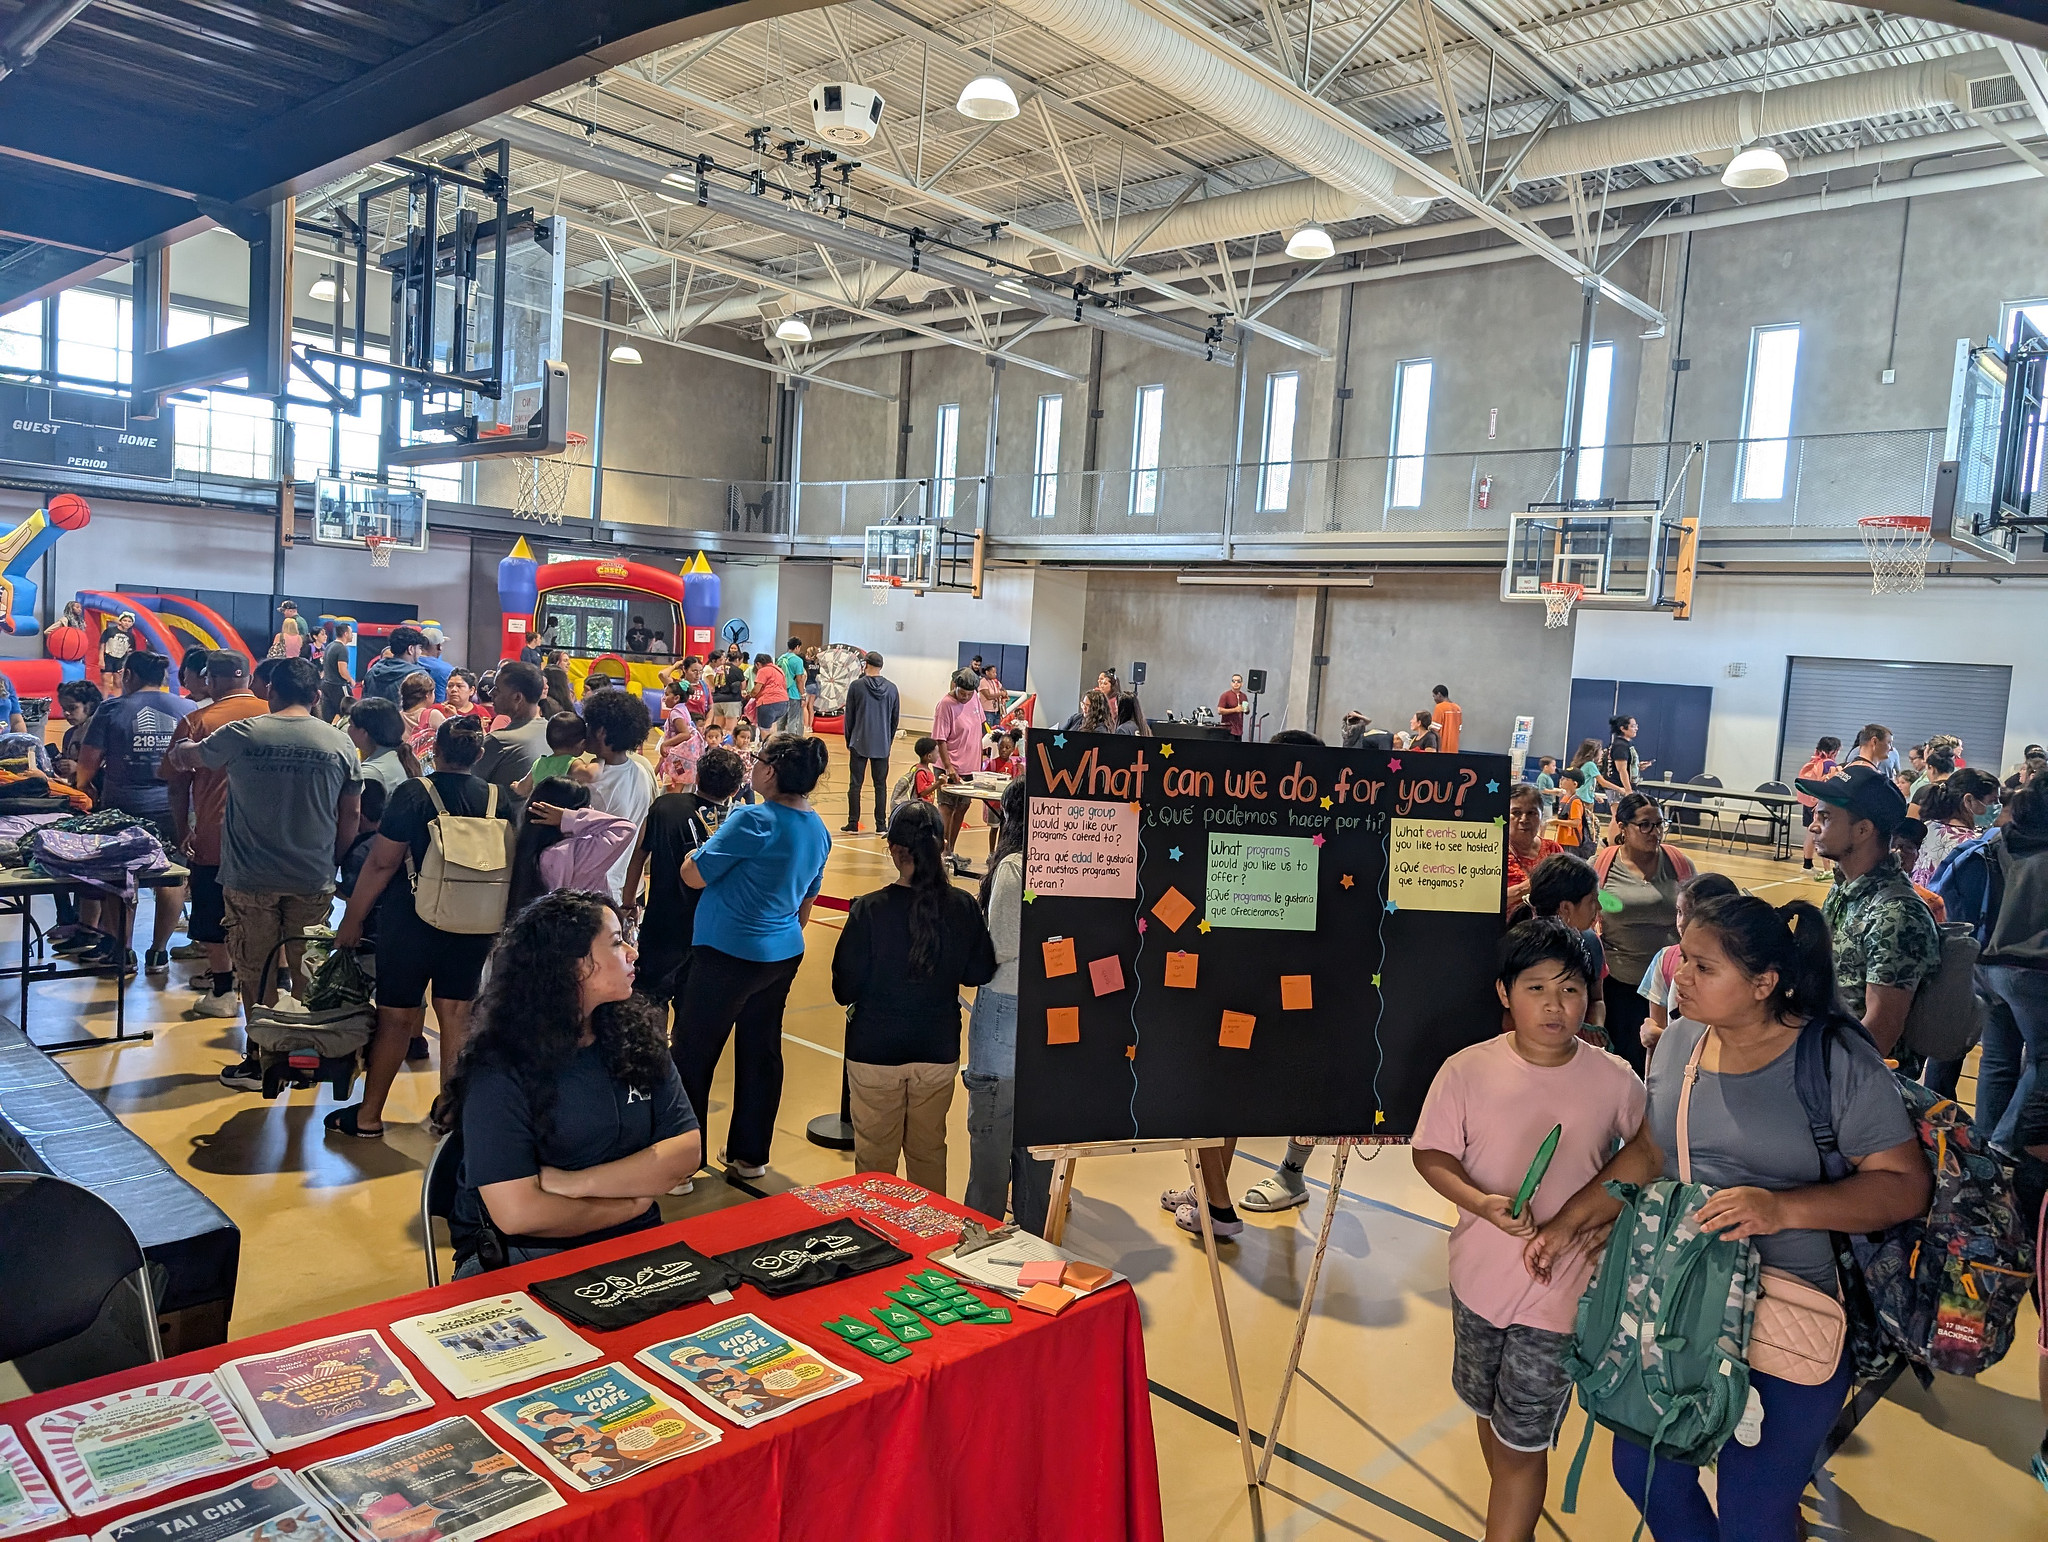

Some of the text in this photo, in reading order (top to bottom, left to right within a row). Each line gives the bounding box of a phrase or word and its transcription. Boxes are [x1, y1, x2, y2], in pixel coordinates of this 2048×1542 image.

[12, 419, 61, 435] GUEST
[118, 433, 158, 448] HOME
[67, 456, 108, 469] PERIOD
[133, 735, 156, 747] 218
[1036, 742, 1478, 817] What can we do for you?
[1032, 802, 1116, 820] What age group
[1032, 818, 1118, 832] would you like our
[1203, 804, 1278, 830] podemos
[1288, 808, 1332, 829] hacer
[1335, 812, 1361, 835] por
[1365, 811, 1386, 835] ti?
[1032, 831, 1068, 842] programs
[1072, 832, 1101, 842] catered
[1395, 824, 1488, 840] What events would
[1211, 839, 1291, 860] What programs
[1395, 840, 1499, 855] you like to see hosted?
[1054, 850, 1069, 864] qué
[1072, 851, 1093, 864] edad
[1097, 852, 1105, 863] le
[1106, 853, 1134, 866] gustaría
[1211, 858, 1308, 872] would you like us to
[1028, 864, 1121, 879] que nuestros programas
[1393, 861, 1501, 879] ¿Qué eventos le gustaría
[1398, 877, 1413, 888] que
[1206, 887, 1231, 902] ¿Qué
[1233, 892, 1272, 905] programas
[1274, 891, 1282, 904] le
[1211, 906, 1285, 920] que ofrecieramos?
[424, 1306, 524, 1335] WEDNESDAYS
[436, 1306, 506, 1328] WALKING
[1937, 1328, 1979, 1344] BACKPACK
[1955, 1324, 1974, 1335] INCH
[714, 1328, 762, 1351] KIDS
[727, 1336, 774, 1358] CAFE
[322, 1347, 352, 1359] 7PM
[745, 1345, 785, 1364] SUMMER TIME
[274, 1359, 303, 1369] FRIDAY
[276, 1361, 309, 1373] AUGUST
[762, 1366, 782, 1375] FREE
[292, 1373, 365, 1398] MOVIE
[301, 1380, 367, 1403] NIGHT
[569, 1380, 622, 1406] KIDS
[311, 1399, 342, 1410] FEATURED
[313, 1397, 369, 1421] Wonka
[582, 1388, 635, 1414] CAFE
[600, 1398, 646, 1420] SUMMER TIME
[116, 1401, 202, 1431] Schedule
[617, 1423, 640, 1433] FREE
[416, 1451, 454, 1467] BOXING
[155, 1513, 202, 1536] TAI
[197, 1497, 249, 1521] CHI
